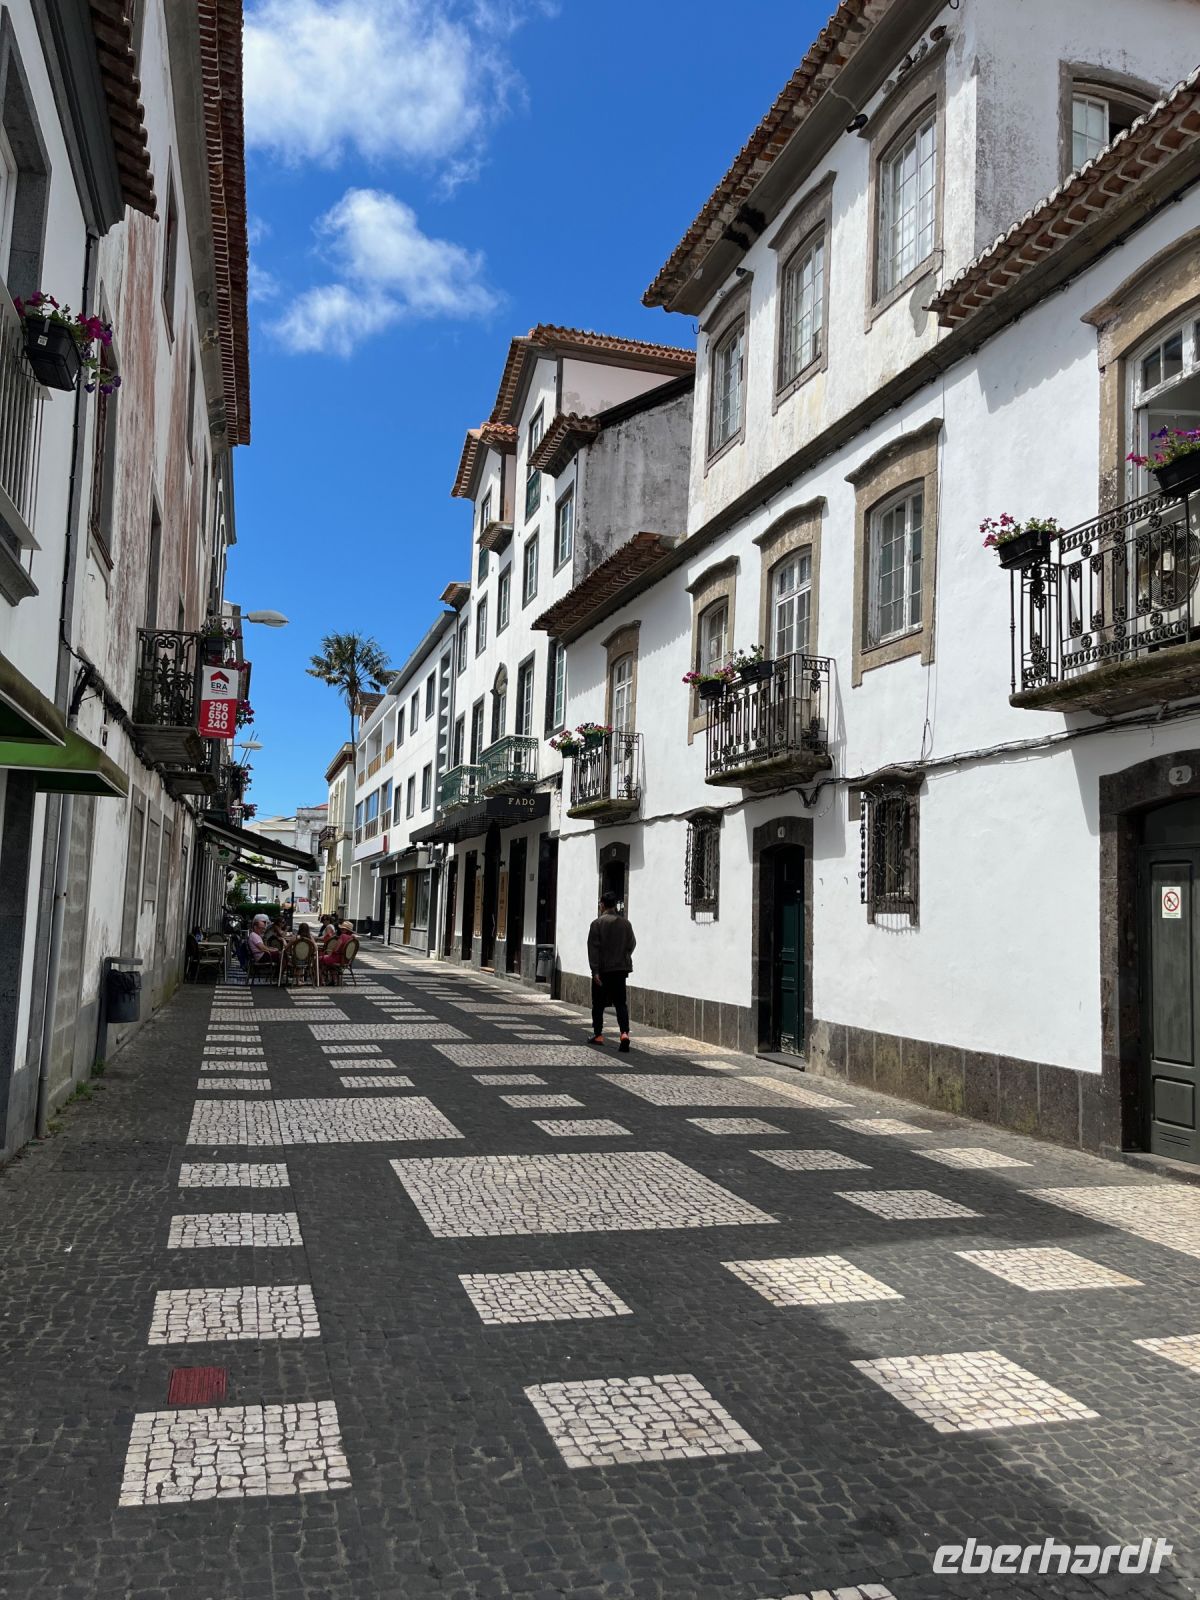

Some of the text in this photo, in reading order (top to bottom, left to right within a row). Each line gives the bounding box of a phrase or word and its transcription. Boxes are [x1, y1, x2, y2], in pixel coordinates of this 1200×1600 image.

[211, 682, 228, 690] ERA
[209, 702, 228, 711] 296
[208, 711, 228, 720] 650
[208, 719, 227, 729] 240
[1176, 770, 1183, 782] 2
[508, 797, 535, 806] FADO
